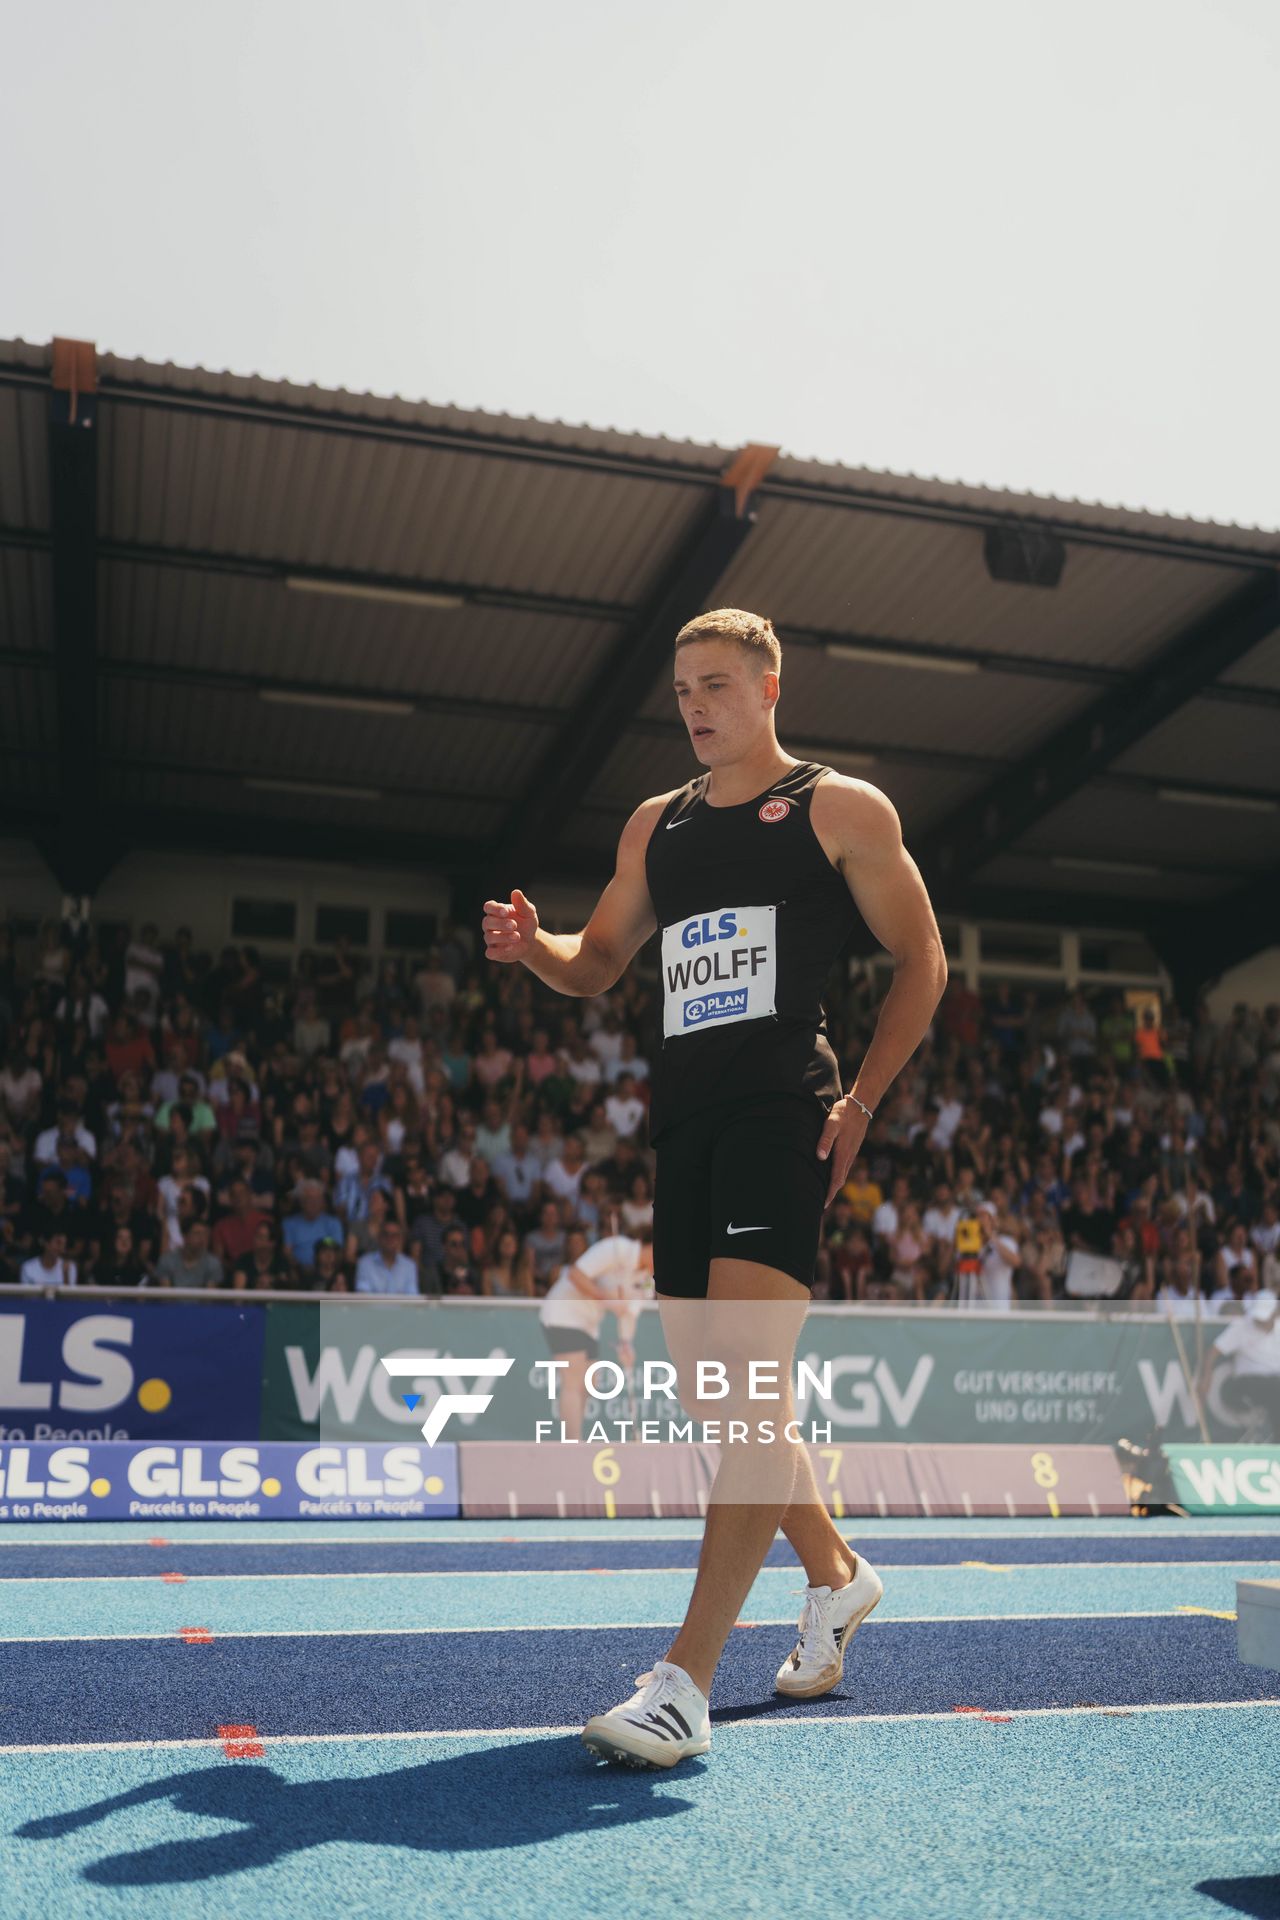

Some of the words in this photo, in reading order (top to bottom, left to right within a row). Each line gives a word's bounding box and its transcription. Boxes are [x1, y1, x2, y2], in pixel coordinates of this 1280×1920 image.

[681, 913, 748, 949] GLS.
[667, 946, 767, 993] WOLFF
[707, 994, 745, 1010] PLAN
[953, 1370, 995, 1394] GUT
[975, 1399, 1018, 1424] UND
[1022, 1399, 1063, 1424] GUT
[127, 1447, 281, 1498] GLS.
[295, 1447, 444, 1498] GLS.
[592, 1448, 621, 1485] 6
[818, 1449, 843, 1484] 7
[1030, 1452, 1059, 1488] 8
[13, 1503, 30, 1518] to
[33, 1502, 88, 1520] People
[129, 1501, 185, 1517] Parcels
[189, 1502, 206, 1516] to
[207, 1500, 260, 1519] People
[299, 1500, 353, 1516] Parcels
[356, 1500, 372, 1516] to
[374, 1499, 425, 1518] People
